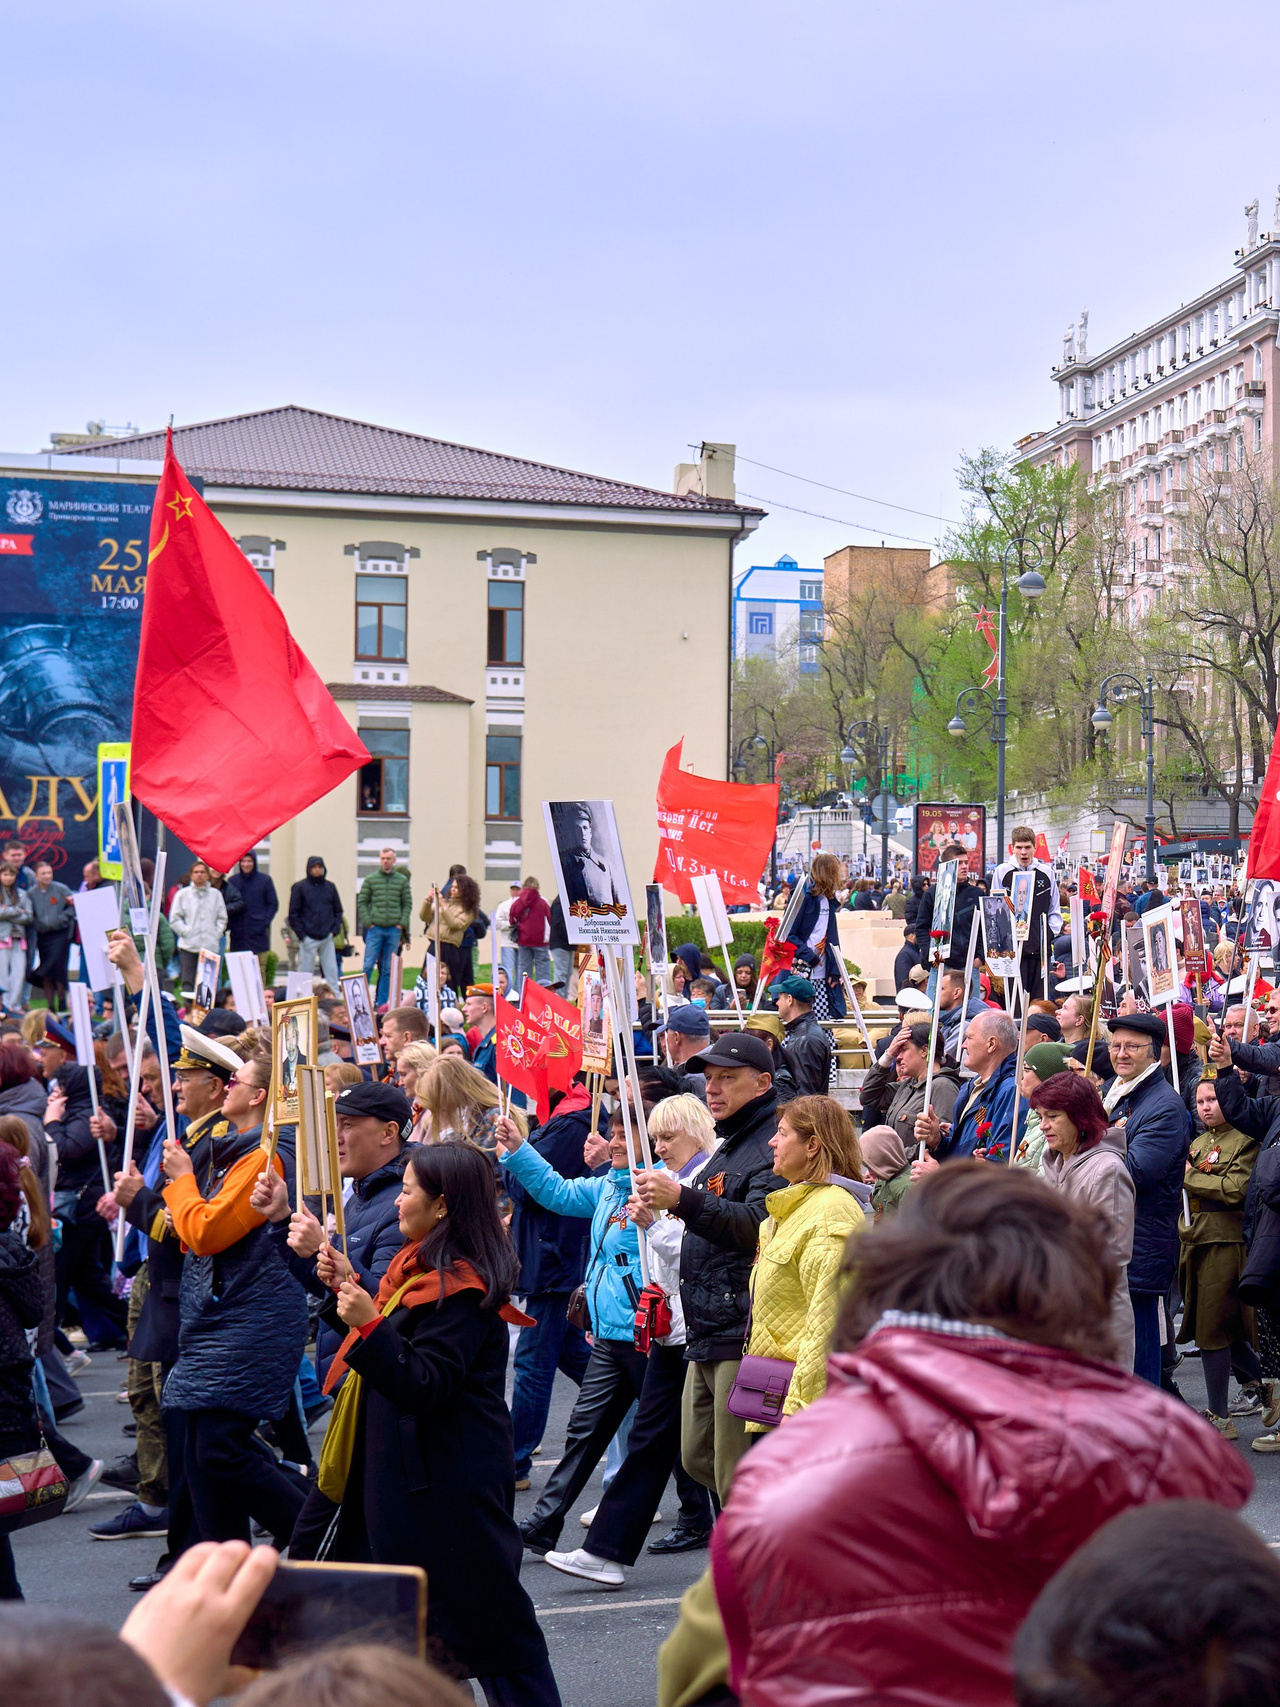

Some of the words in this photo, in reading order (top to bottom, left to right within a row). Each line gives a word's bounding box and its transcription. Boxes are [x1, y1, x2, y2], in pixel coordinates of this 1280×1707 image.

[48, 500, 119, 513] МАРИИНСКИЙ
[121, 502, 151, 514] ТЕАТР
[0, 538, 17, 550] РА
[98, 538, 143, 571] 25
[91, 573, 147, 594] МАЯ
[101, 595, 139, 610] 17:00
[922, 810, 942, 818] 19.05
